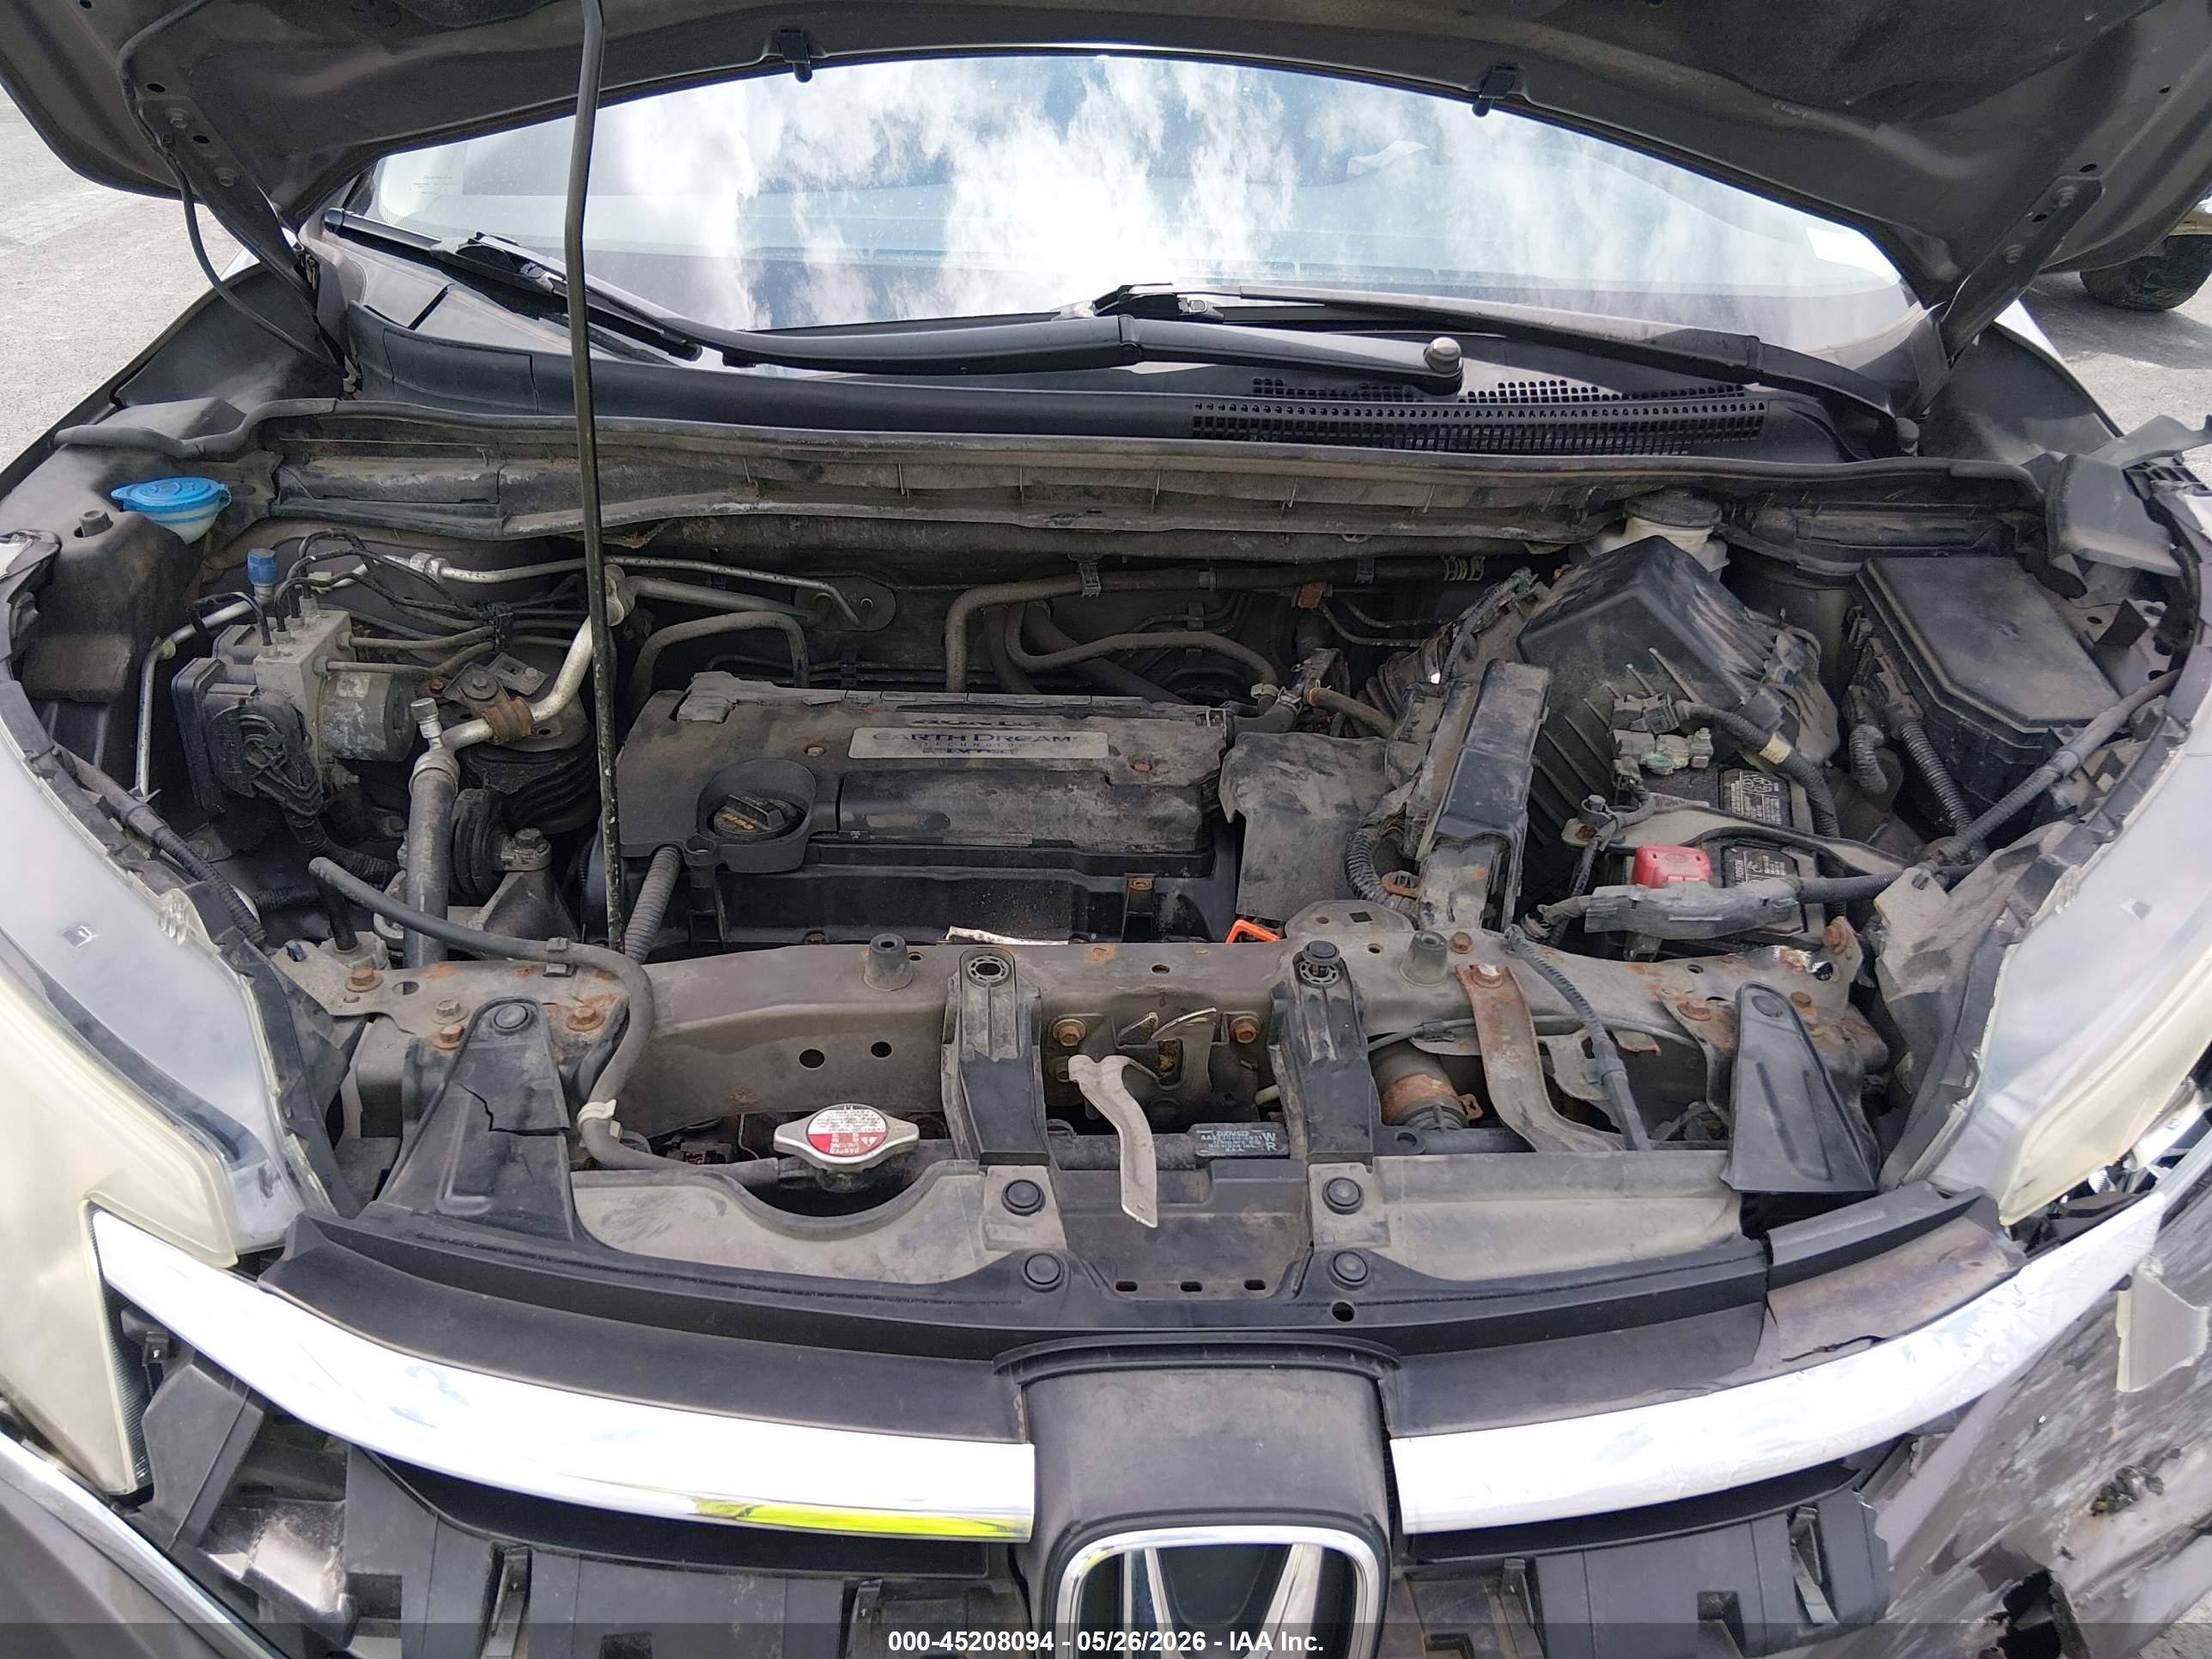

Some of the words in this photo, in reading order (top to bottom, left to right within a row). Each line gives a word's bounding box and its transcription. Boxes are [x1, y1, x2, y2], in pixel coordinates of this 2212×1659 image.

[872, 732, 966, 742] EARTH
[1262, 1132, 1276, 1142] W
[1266, 1142, 1277, 1152] R
